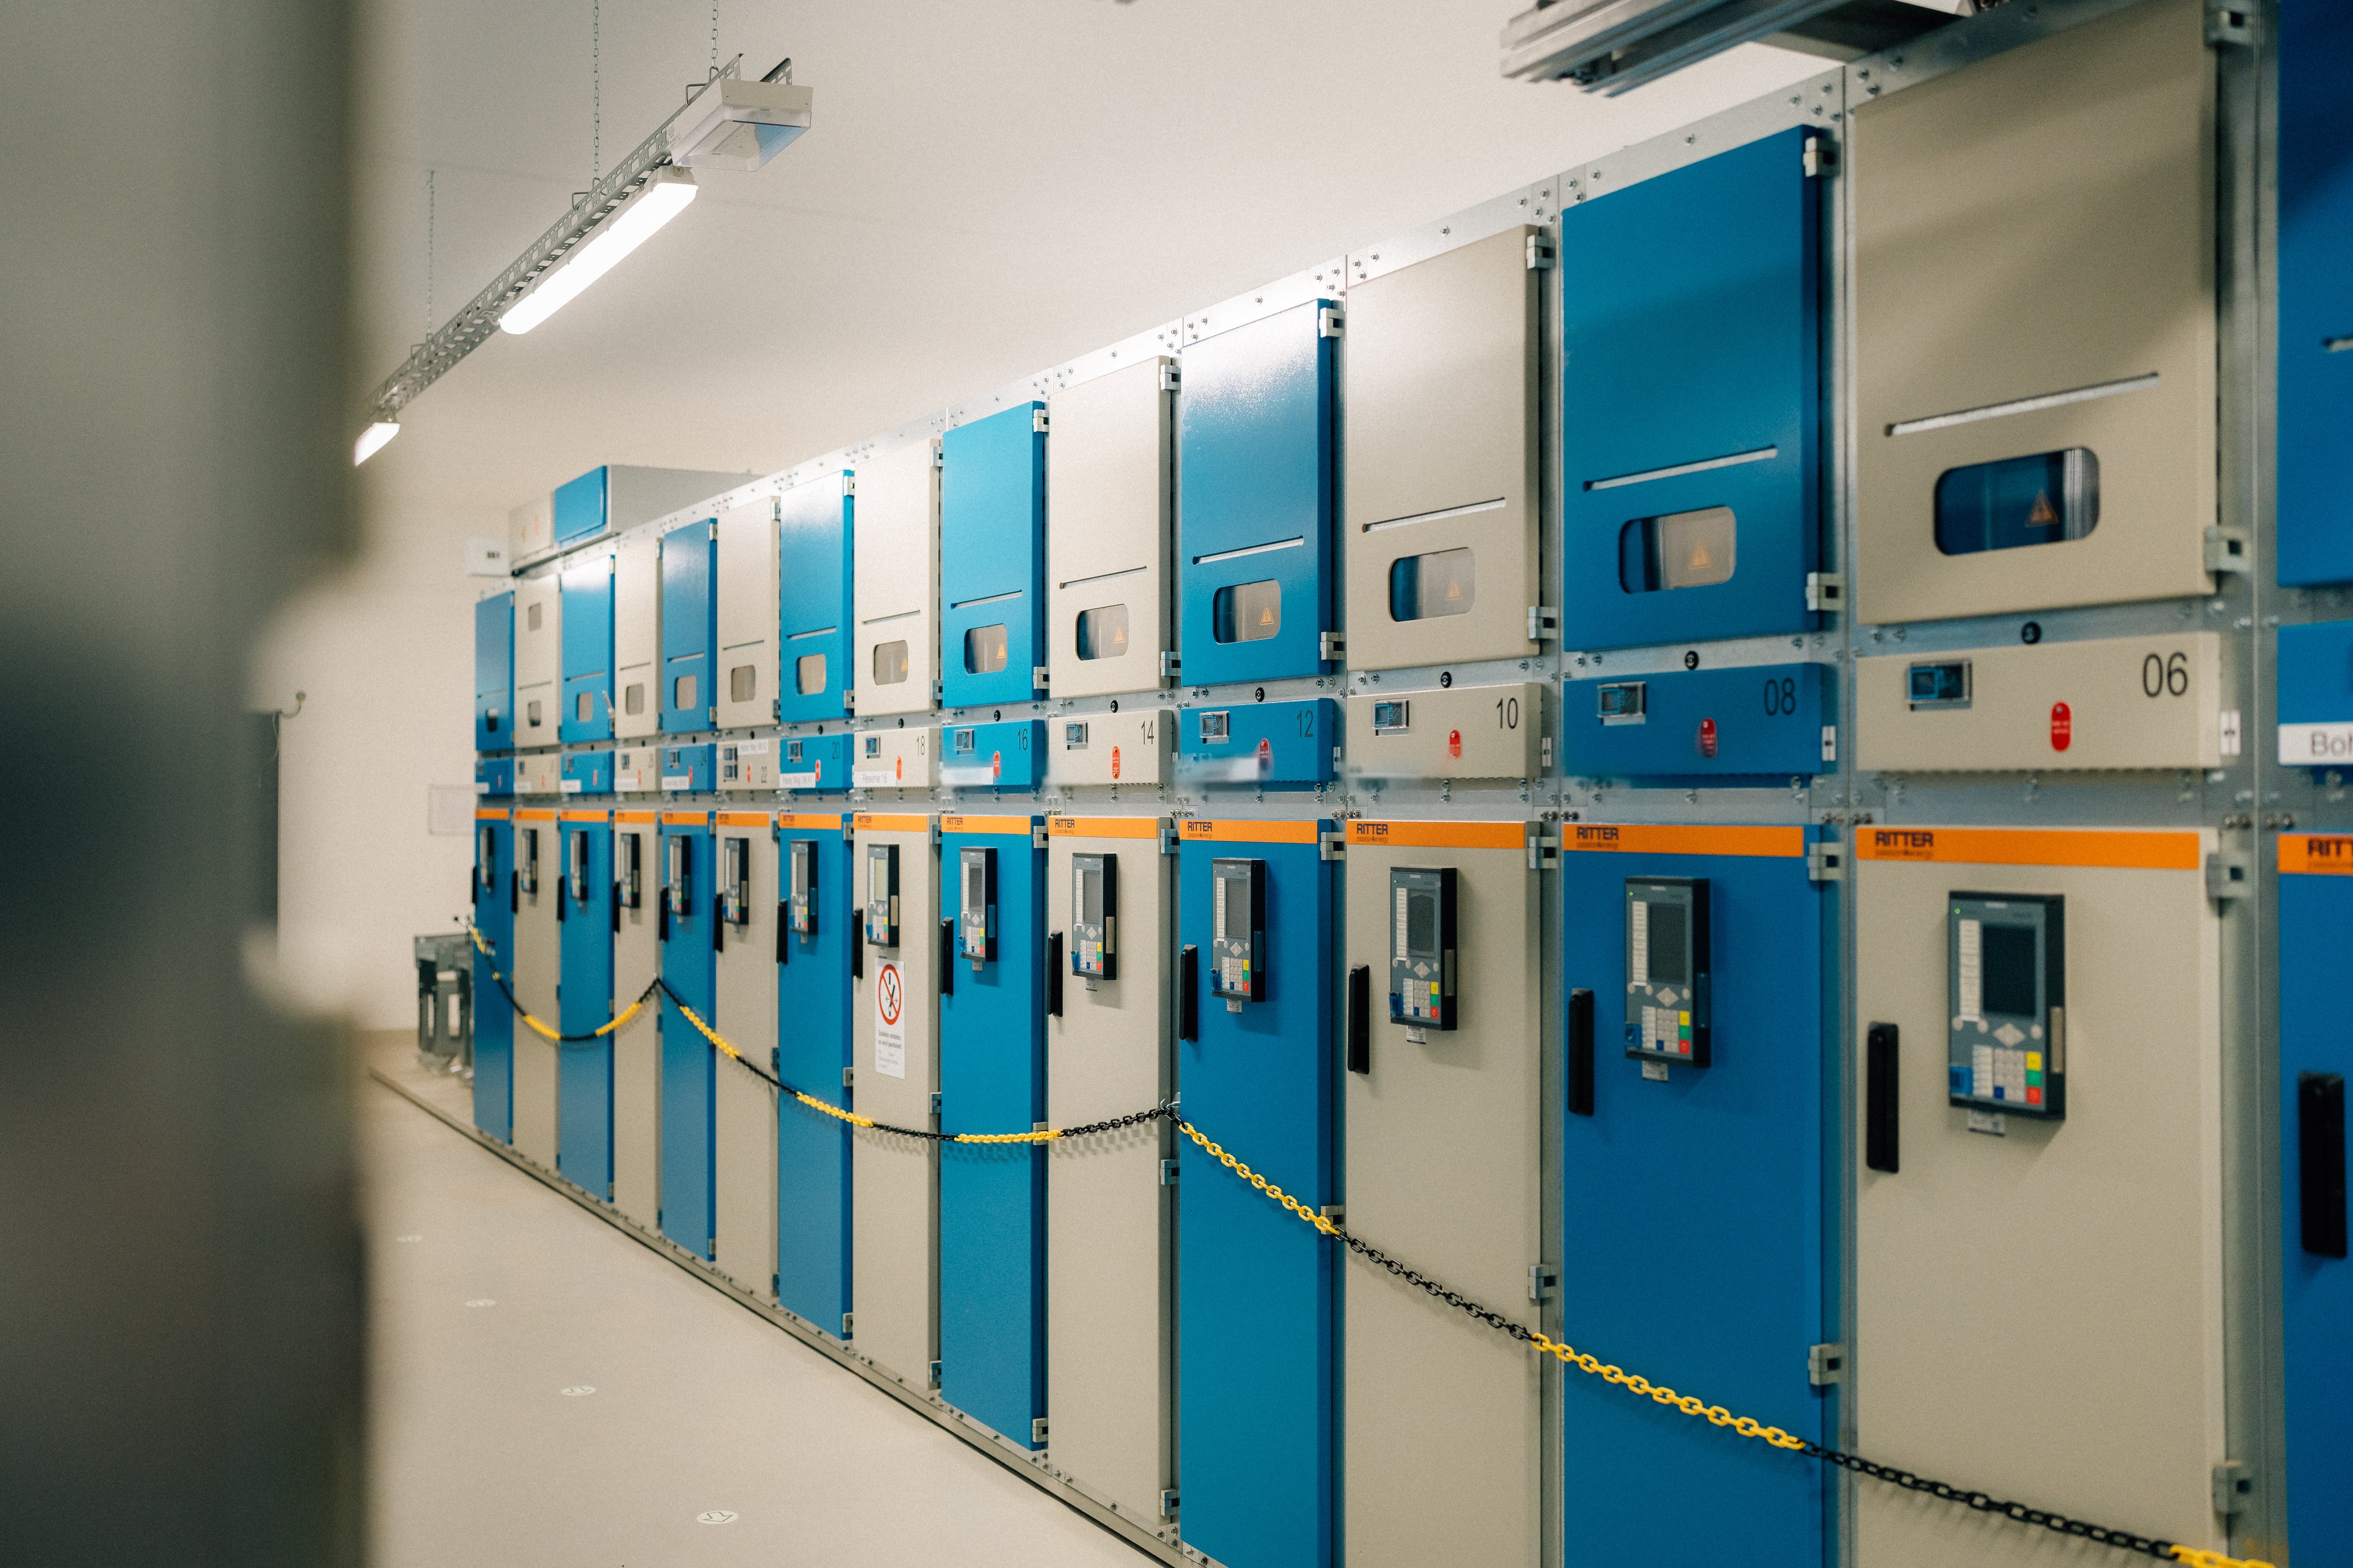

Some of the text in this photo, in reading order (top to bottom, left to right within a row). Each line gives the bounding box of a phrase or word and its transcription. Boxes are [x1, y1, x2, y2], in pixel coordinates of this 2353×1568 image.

[2142, 651, 2189, 698] 06
[1763, 677, 1797, 716] 08
[1496, 697, 1519, 730] 10
[1141, 720, 1154, 745] 14
[1297, 710, 1314, 738] 12
[916, 735, 925, 756] 18
[1017, 728, 1028, 751] 16
[2310, 731, 2353, 756] Bo
[832, 741, 840, 760] 20
[761, 766, 767, 783] 22
[862, 773, 887, 783] Reserve 18
[947, 817, 963, 825] RITTER
[1055, 819, 1075, 828] RITTER
[1187, 821, 1212, 832] RITTER
[1356, 823, 1388, 835] RITTER
[1577, 827, 1619, 840] RITTER
[1875, 831, 1934, 847] RITTER
